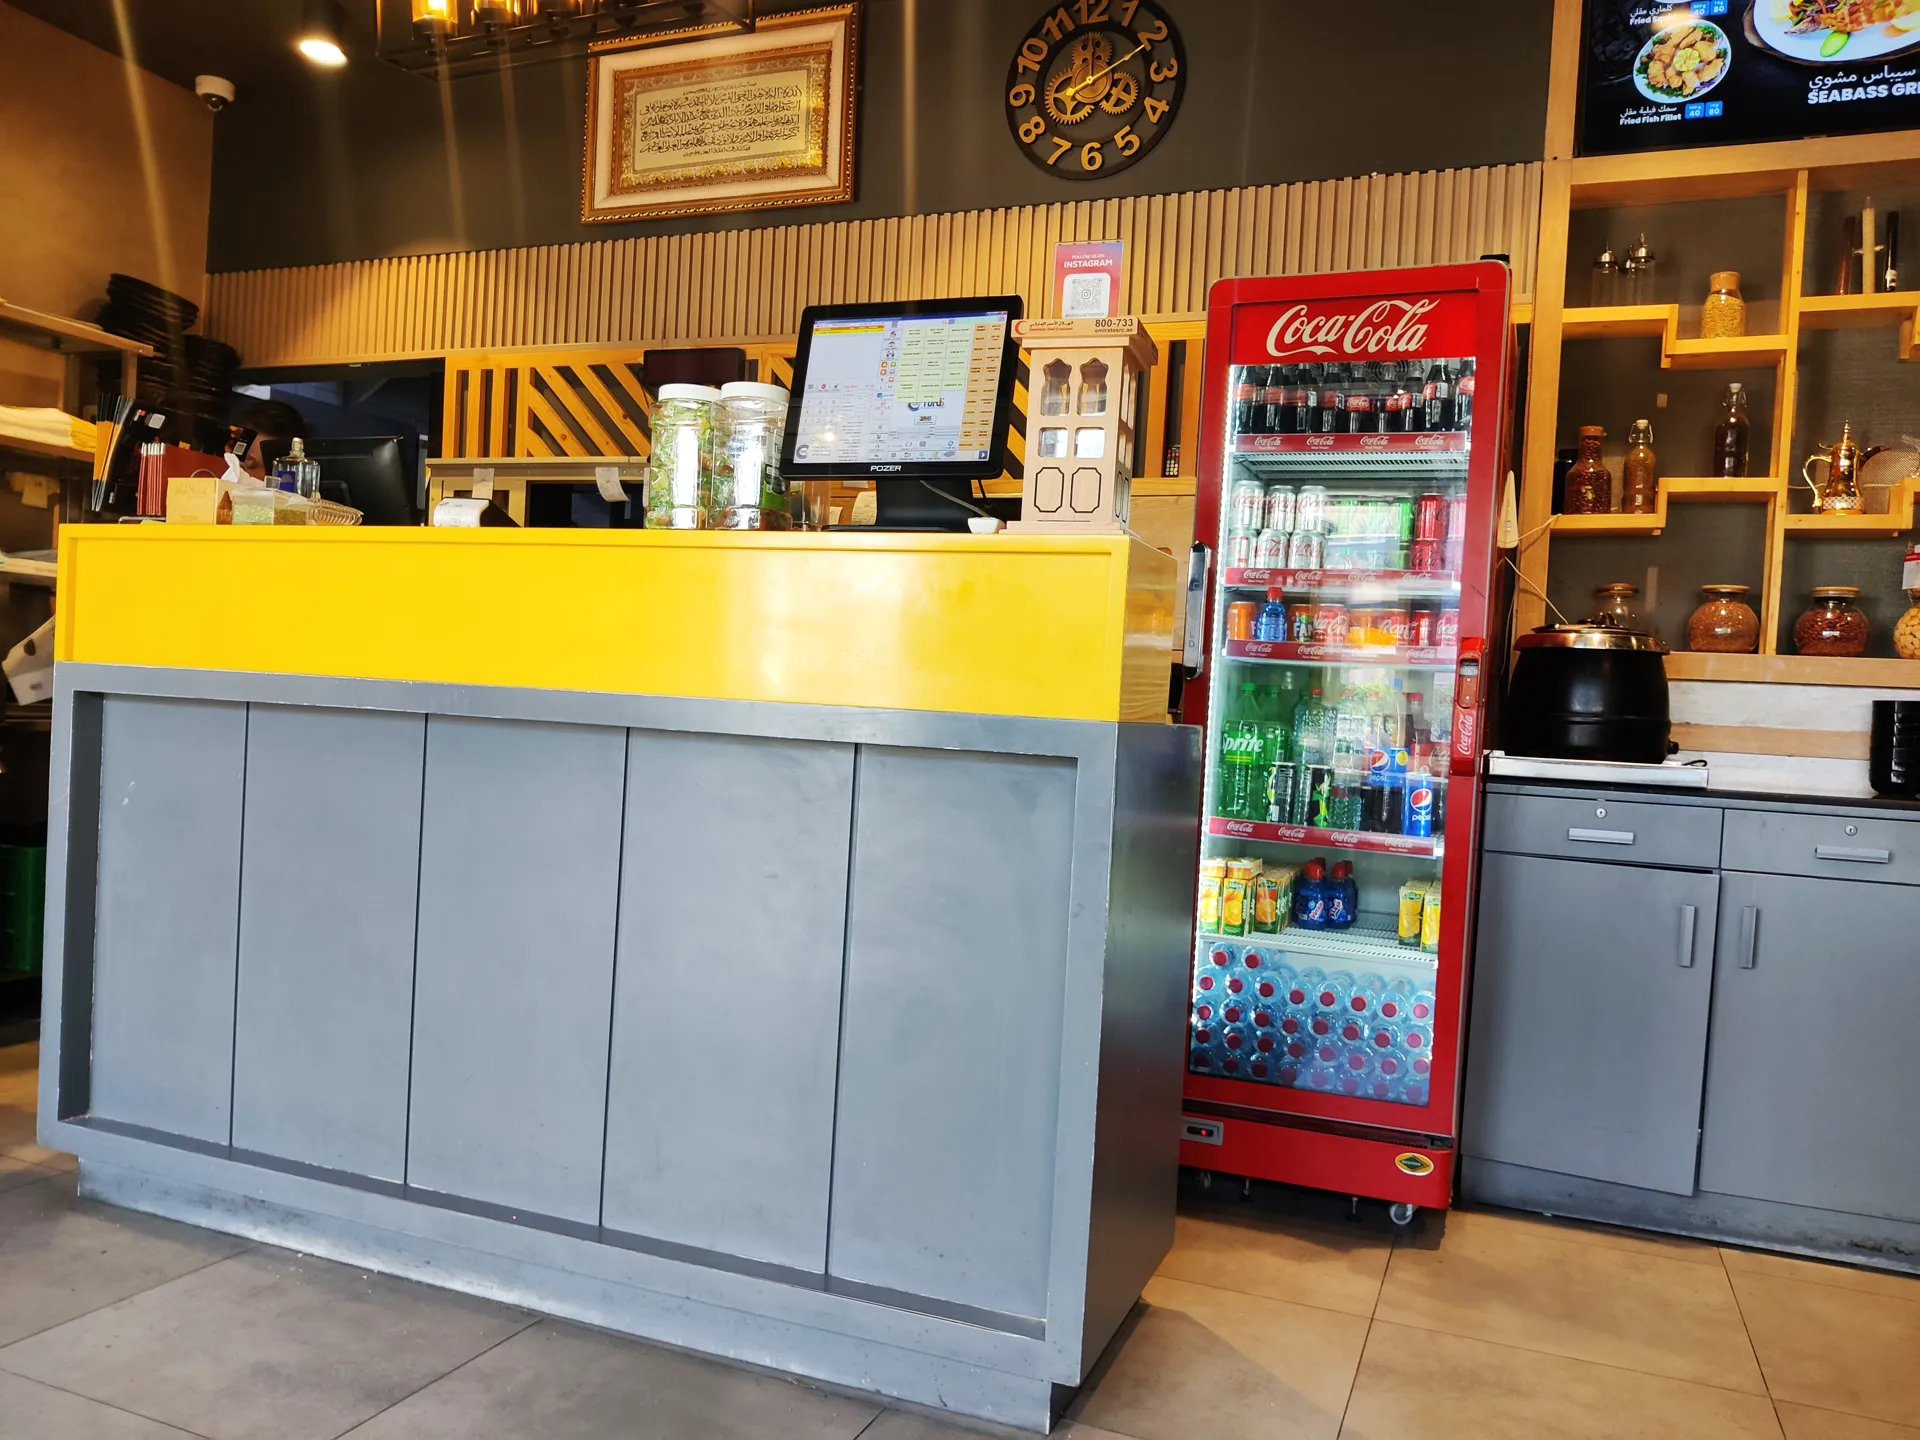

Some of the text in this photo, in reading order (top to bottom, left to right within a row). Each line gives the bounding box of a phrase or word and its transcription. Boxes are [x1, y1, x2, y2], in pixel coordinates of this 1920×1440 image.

[1042, 7, 1076, 40] 11
[1072, 0, 1109, 24] 12
[1121, 0, 1140, 26] 1
[1629, 16, 1651, 25] Fried
[1138, 20, 1168, 50] 2
[1017, 38, 1048, 74] 10
[1150, 58, 1178, 82] 3
[1809, 64, 1917, 92] سيباس مشوي
[1010, 84, 1035, 107] 9
[1808, 84, 1889, 104] SEABASS
[1144, 96, 1170, 124] 4
[1642, 115, 1660, 123] Fish
[1661, 114, 1681, 122] Fillet
[1019, 116, 1046, 144] 8
[1114, 125, 1140, 156] 5
[1047, 136, 1072, 165] 7
[1080, 142, 1103, 170] 6
[1064, 259, 1113, 268] INSTAGRAM
[1095, 319, 1133, 327] 800-733
[1266, 298, 1440, 356] Coca-Cola
[1457, 712, 1472, 755] Coca-Cola
